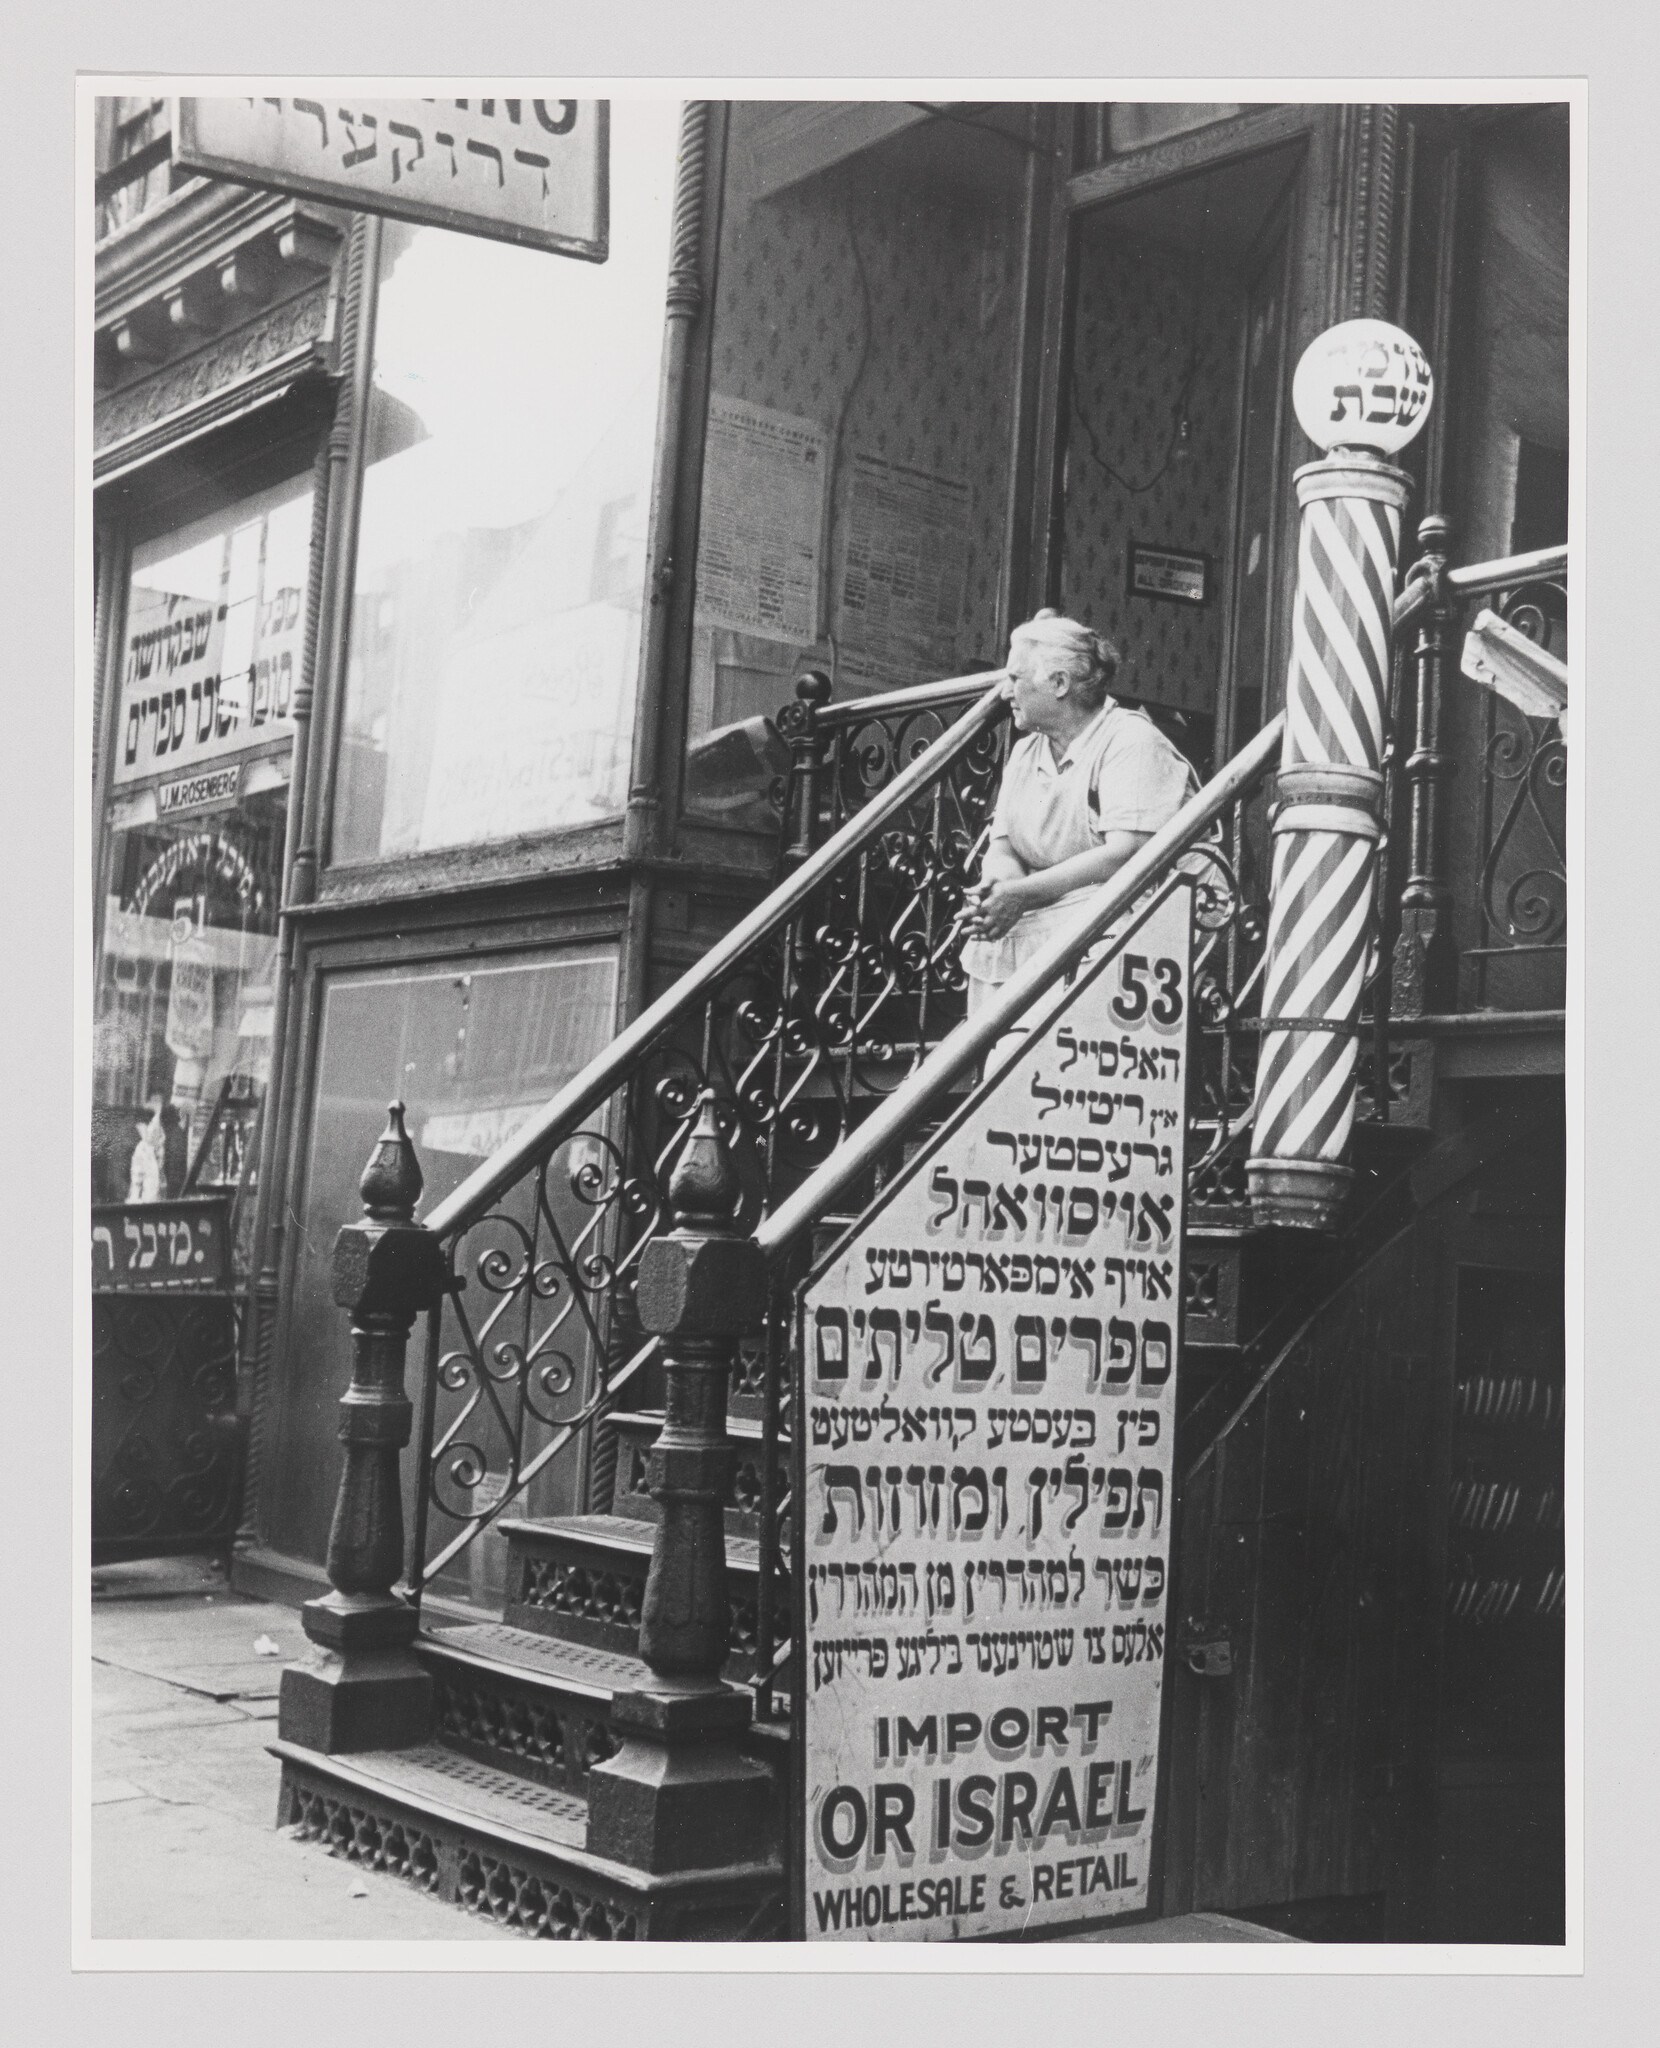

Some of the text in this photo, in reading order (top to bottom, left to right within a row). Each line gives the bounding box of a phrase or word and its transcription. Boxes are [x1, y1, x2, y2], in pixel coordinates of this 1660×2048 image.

[1330, 384, 1427, 428] שבת
[125, 687, 187, 765] ספרים
[171, 894, 206, 943] 51
[1111, 952, 1184, 1026] 53
[1056, 1027, 1181, 1082] האלסייל
[1031, 1071, 1179, 1138] אין ריטייל
[986, 1128, 1174, 1183] גרעסטער
[930, 1165, 1176, 1246] אויסוואהל
[1103, 1255, 1174, 1308] אויף
[814, 1299, 997, 1384] טליתים
[810, 1393, 977, 1452] קוואליטעט
[1116, 1408, 1161, 1455] פין
[821, 1464, 1010, 1536] ומזוזות
[808, 1561, 919, 1624] המהדרין
[925, 1559, 957, 1617] מן
[963, 1543, 1087, 1617] למהדרין
[965, 1627, 1075, 1677] שטוינענד
[1082, 1626, 1108, 1665] צו
[1111, 1616, 1165, 1667] אלעס
[876, 1699, 1114, 1759] IMPORT
[812, 1851, 1139, 1933] WHOLESALE & RETAIL
